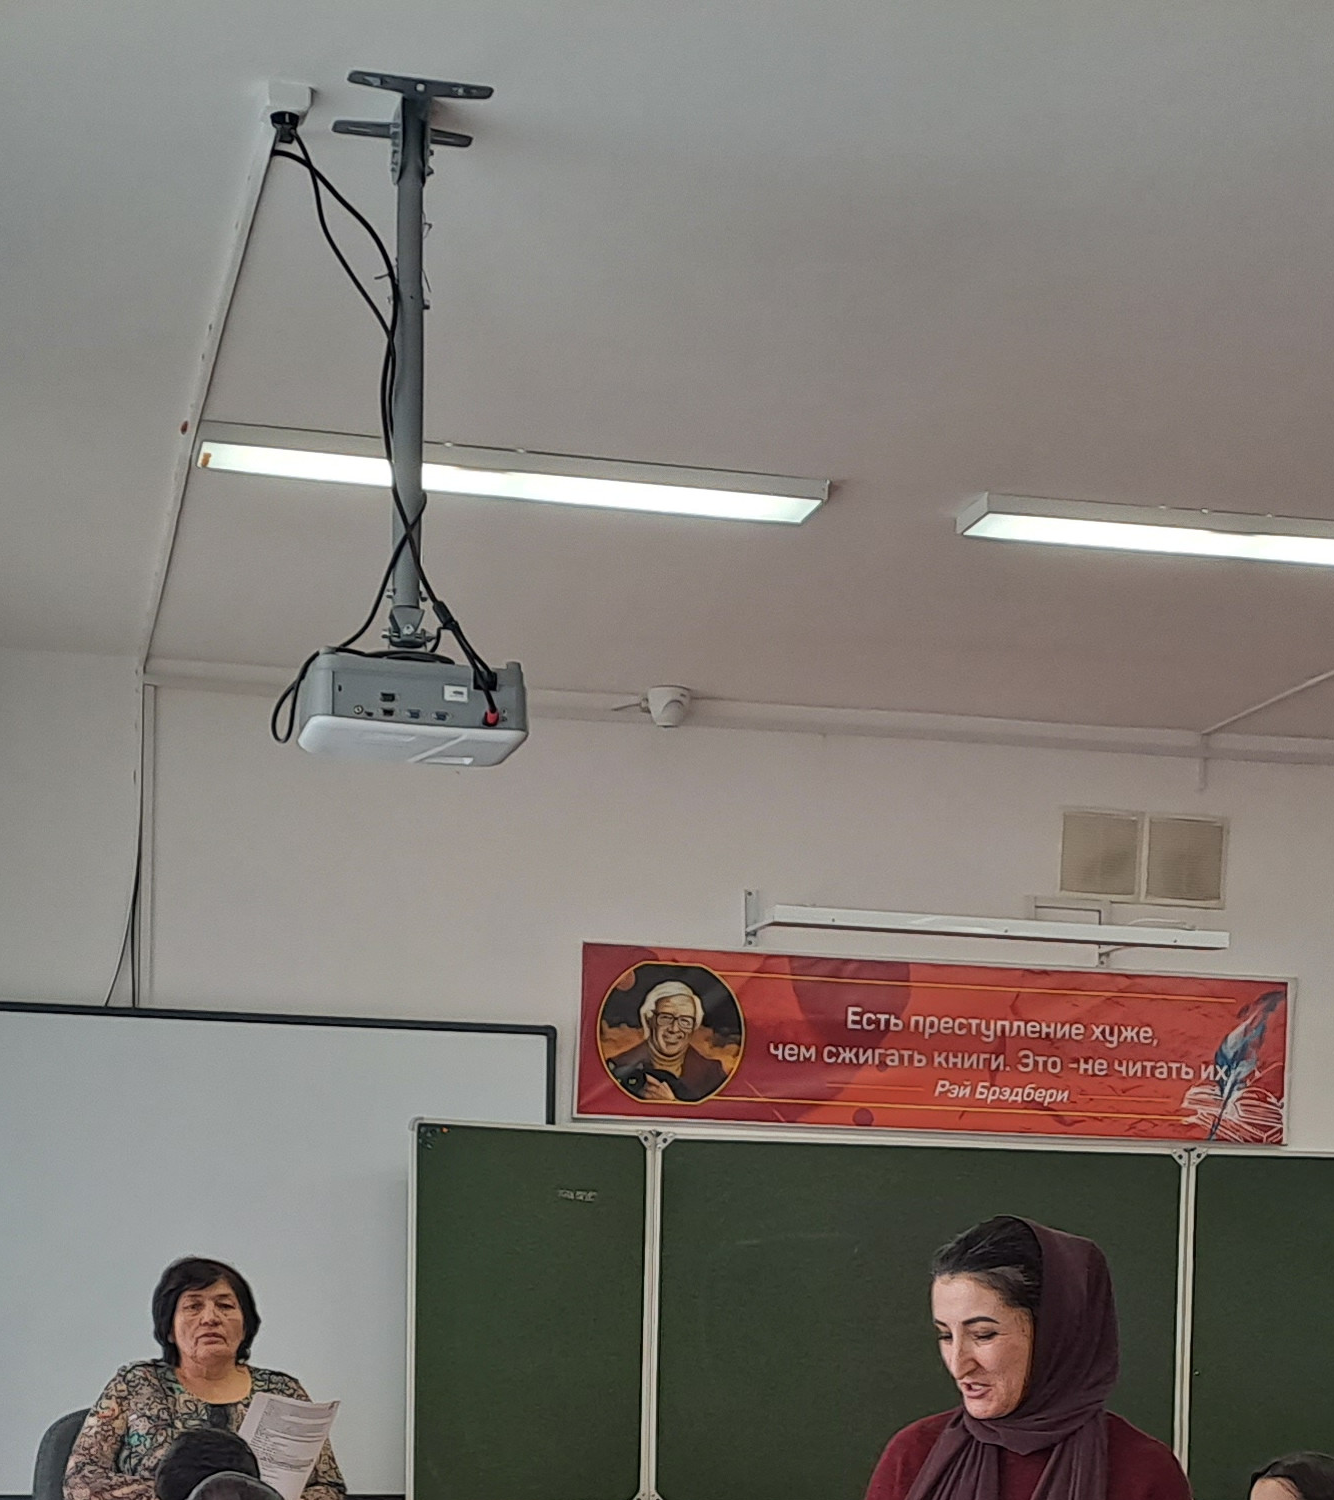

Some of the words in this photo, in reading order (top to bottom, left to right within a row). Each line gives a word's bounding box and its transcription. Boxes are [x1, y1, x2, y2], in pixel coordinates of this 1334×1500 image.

[846, 1006, 904, 1032] Есть
[909, 1014, 1085, 1043] преступление
[1091, 1023, 1159, 1049] хуже,
[769, 1043, 817, 1062] чем
[822, 1045, 927, 1067] сжигать
[933, 1050, 1011, 1072] книги.
[1017, 1049, 1062, 1074] Это
[1114, 1060, 1194, 1081] читать
[934, 1079, 972, 1099] Рэй
[974, 1081, 1070, 1107] Брэдбери
